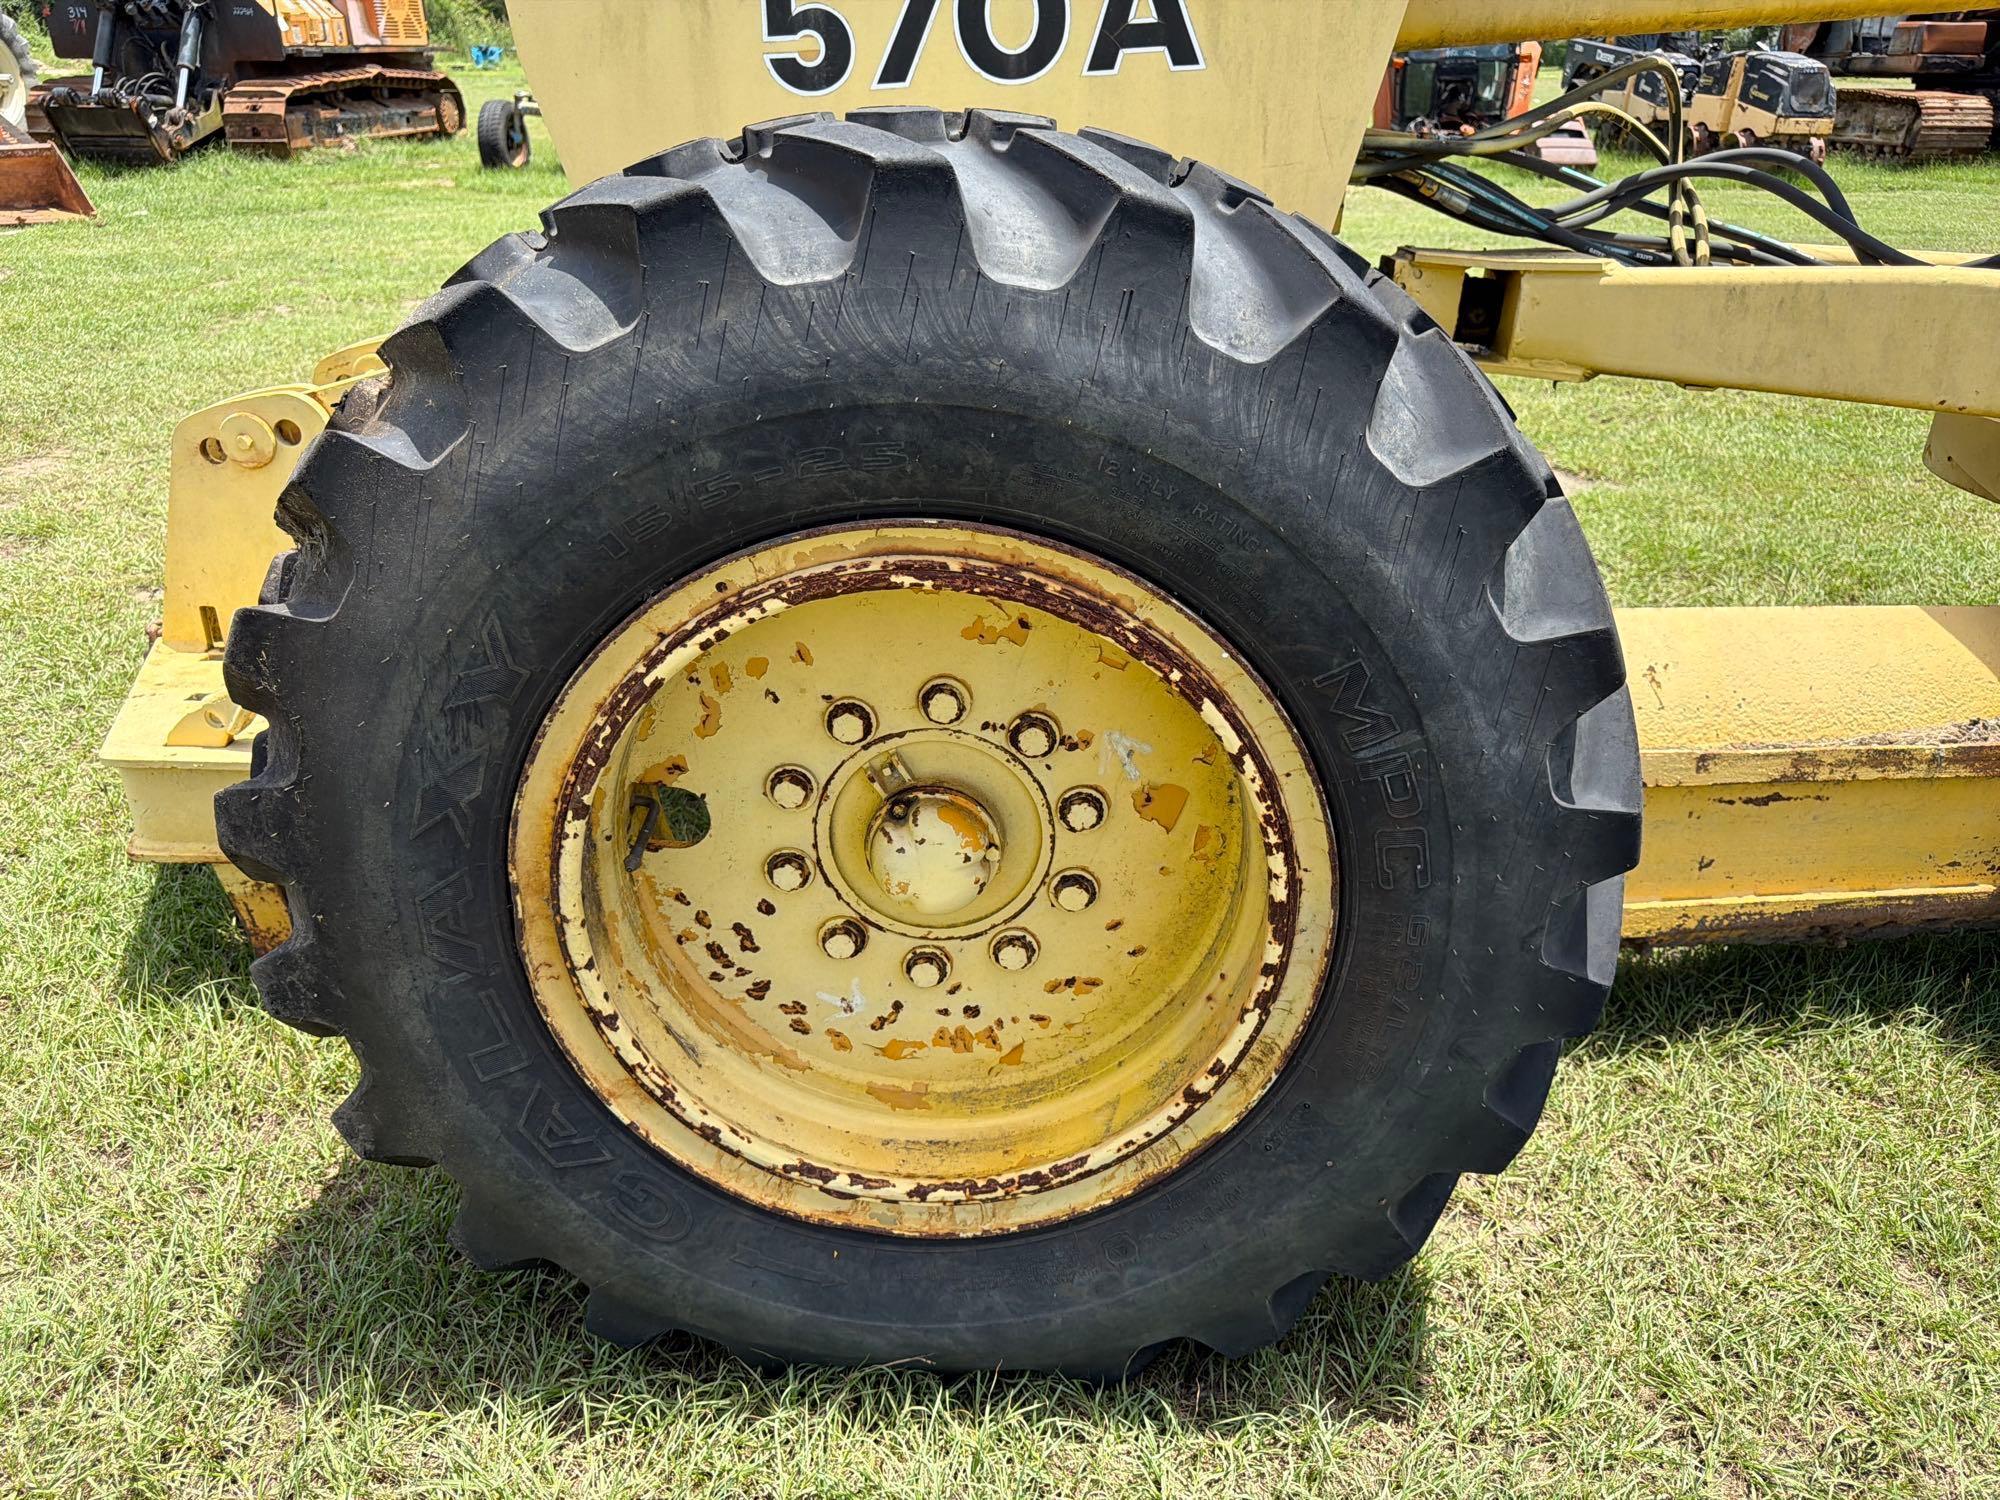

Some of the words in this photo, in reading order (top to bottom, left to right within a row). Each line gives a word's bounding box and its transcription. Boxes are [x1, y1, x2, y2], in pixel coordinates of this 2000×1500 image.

[1098, 455, 1121, 478] 12
[1135, 470, 1180, 500] PLY
[1191, 501, 1260, 553] RATING
[1312, 657, 1433, 890] MPC
